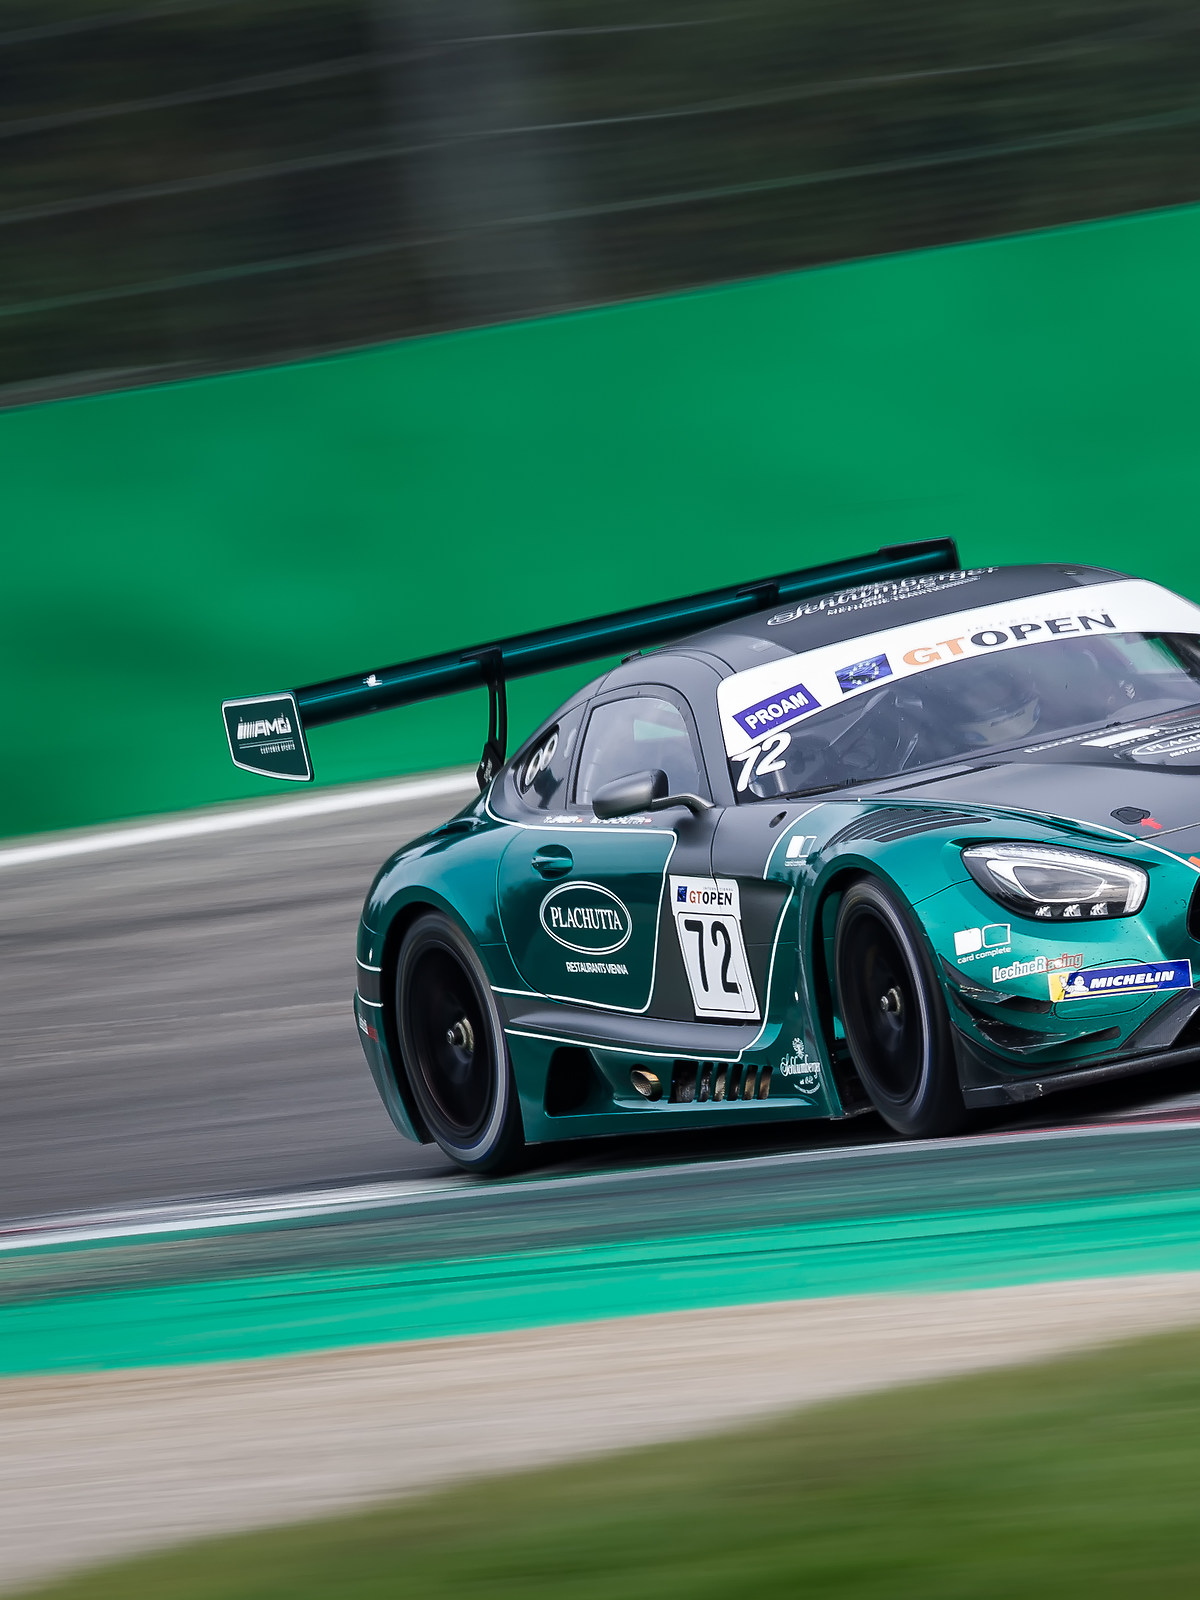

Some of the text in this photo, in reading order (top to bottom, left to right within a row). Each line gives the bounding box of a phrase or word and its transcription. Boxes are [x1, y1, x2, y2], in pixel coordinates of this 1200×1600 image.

[744, 691, 809, 730] PROAM
[731, 731, 792, 792] 72
[550, 906, 624, 931] PLACHUTTA
[684, 919, 742, 995] 72
[957, 946, 1011, 964] card complete
[1089, 970, 1175, 989] MICHELIN
